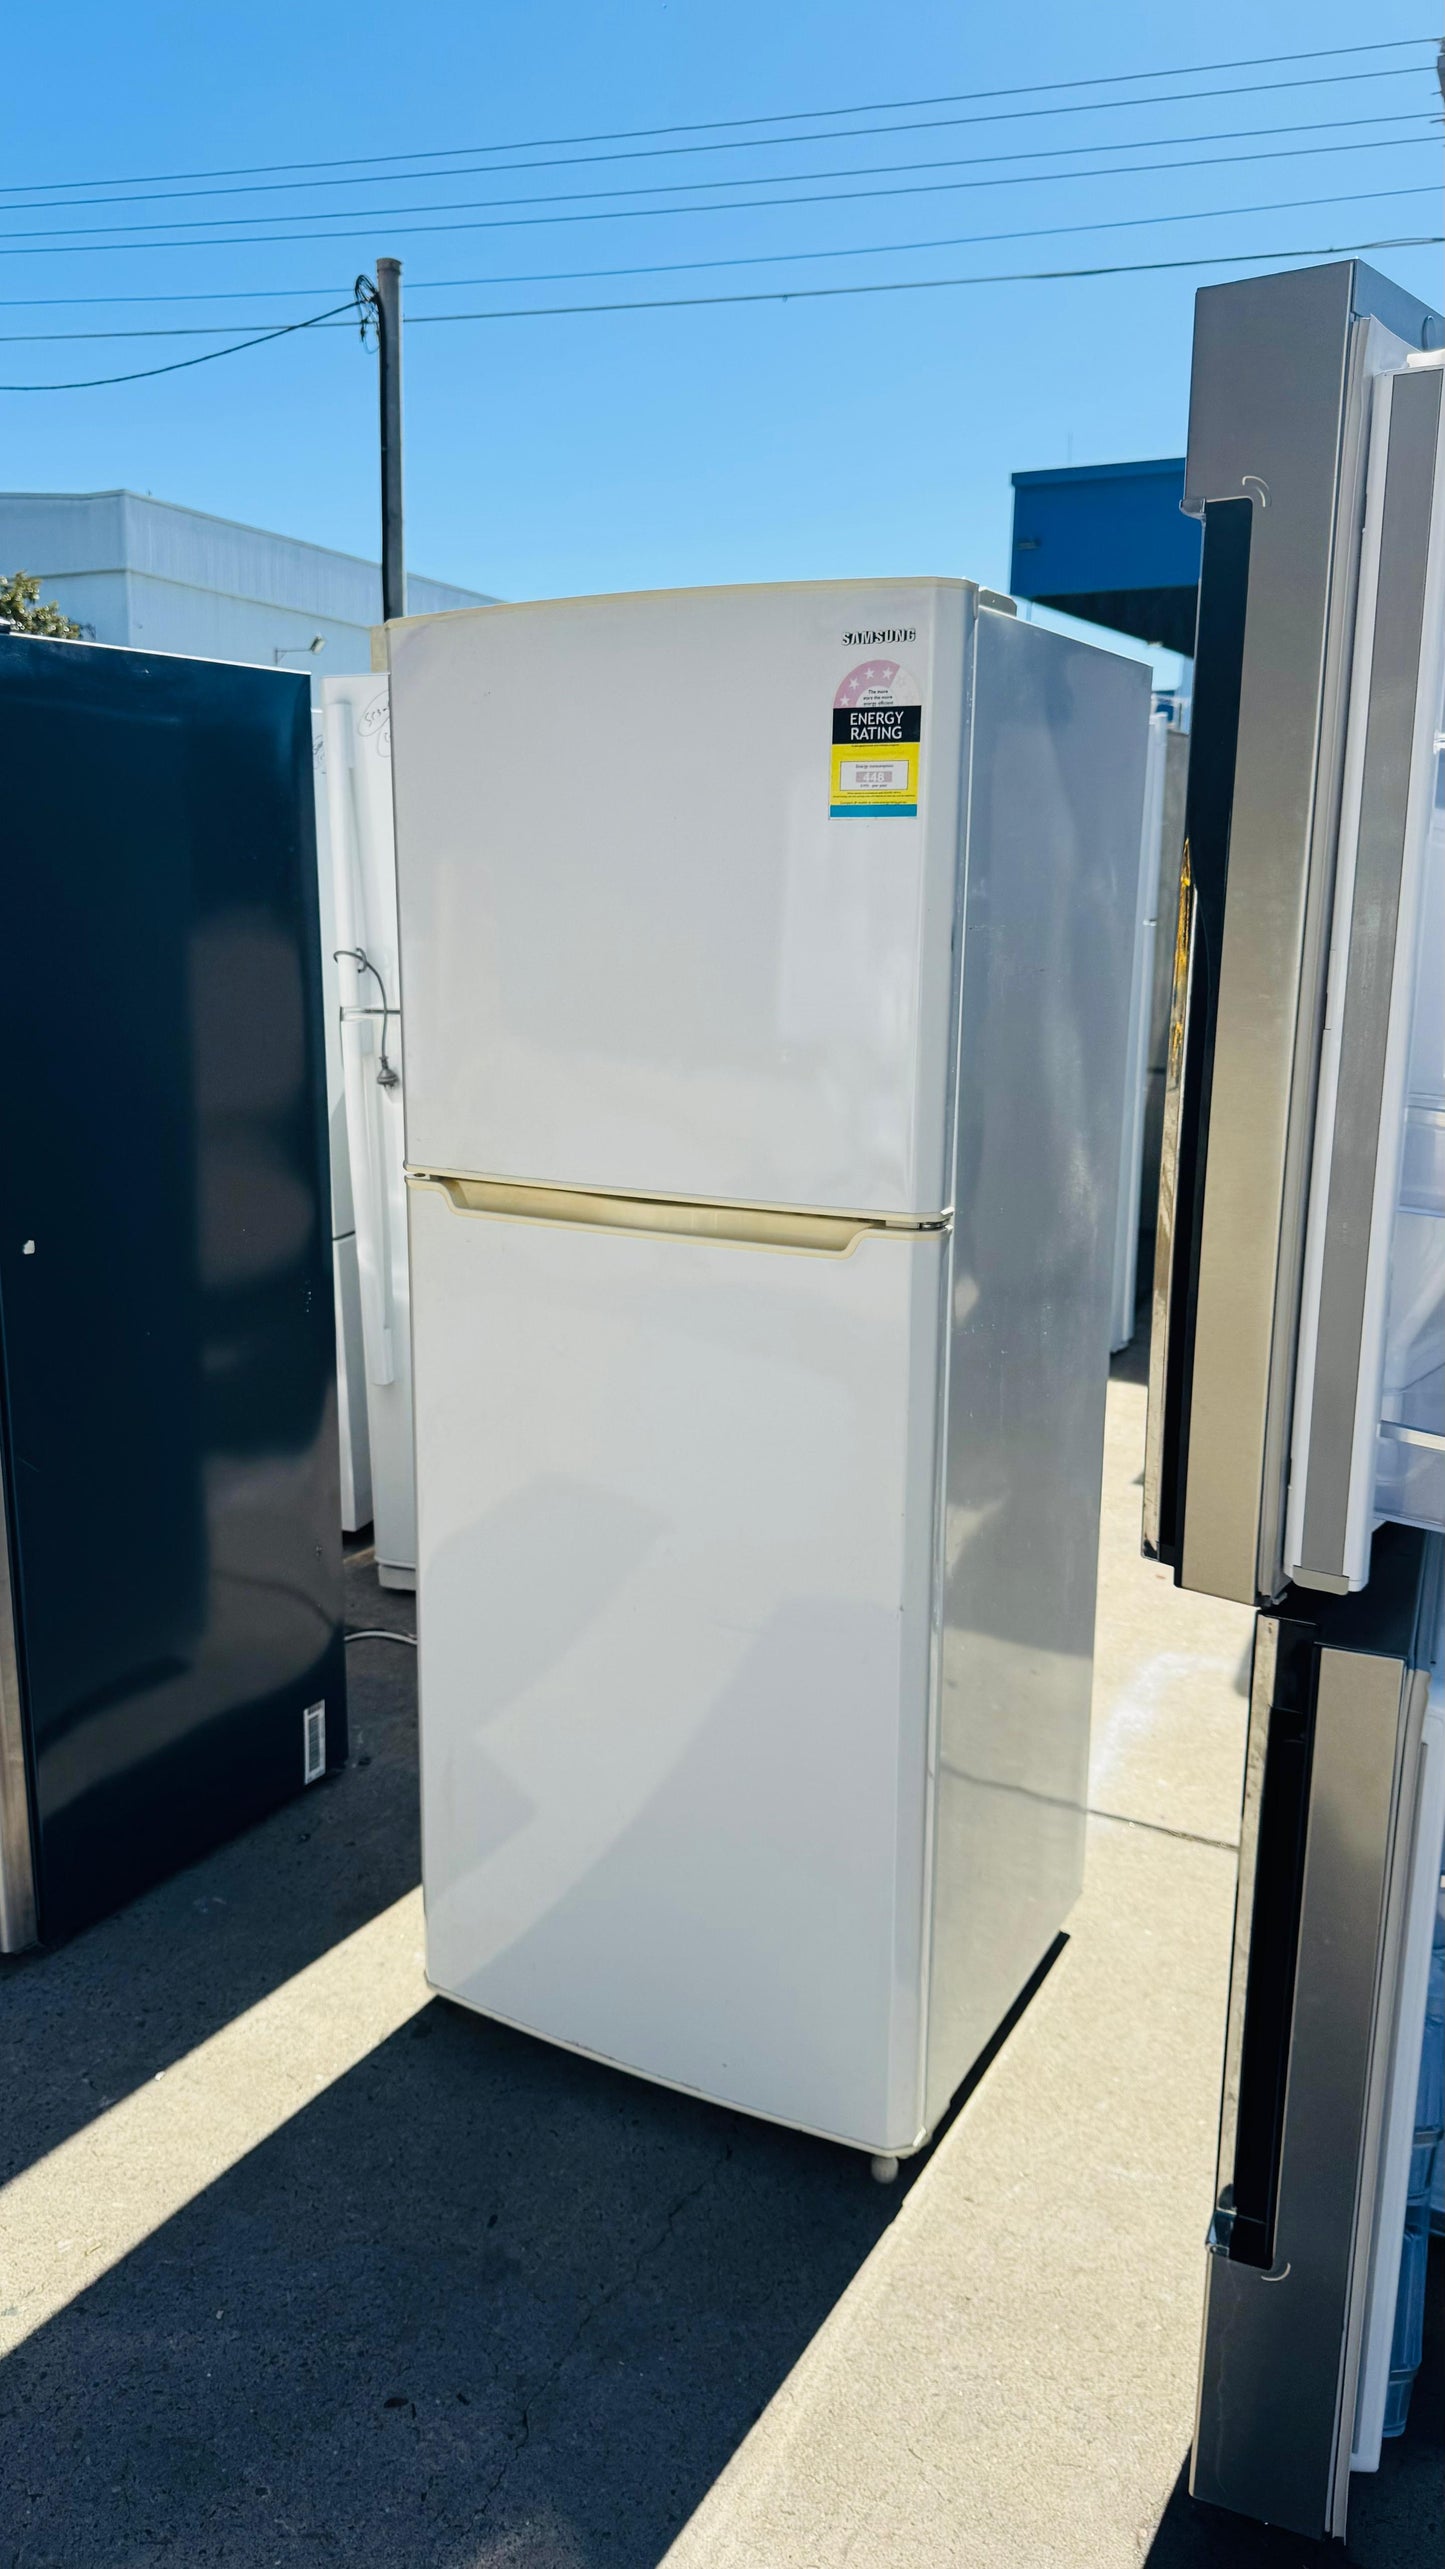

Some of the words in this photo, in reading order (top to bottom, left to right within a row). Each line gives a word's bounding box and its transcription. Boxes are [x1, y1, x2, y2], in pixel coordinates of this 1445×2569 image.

[842, 628, 916, 645] SAMSUNG
[850, 711, 904, 725] ENERGY
[850, 726, 902, 740] RATING
